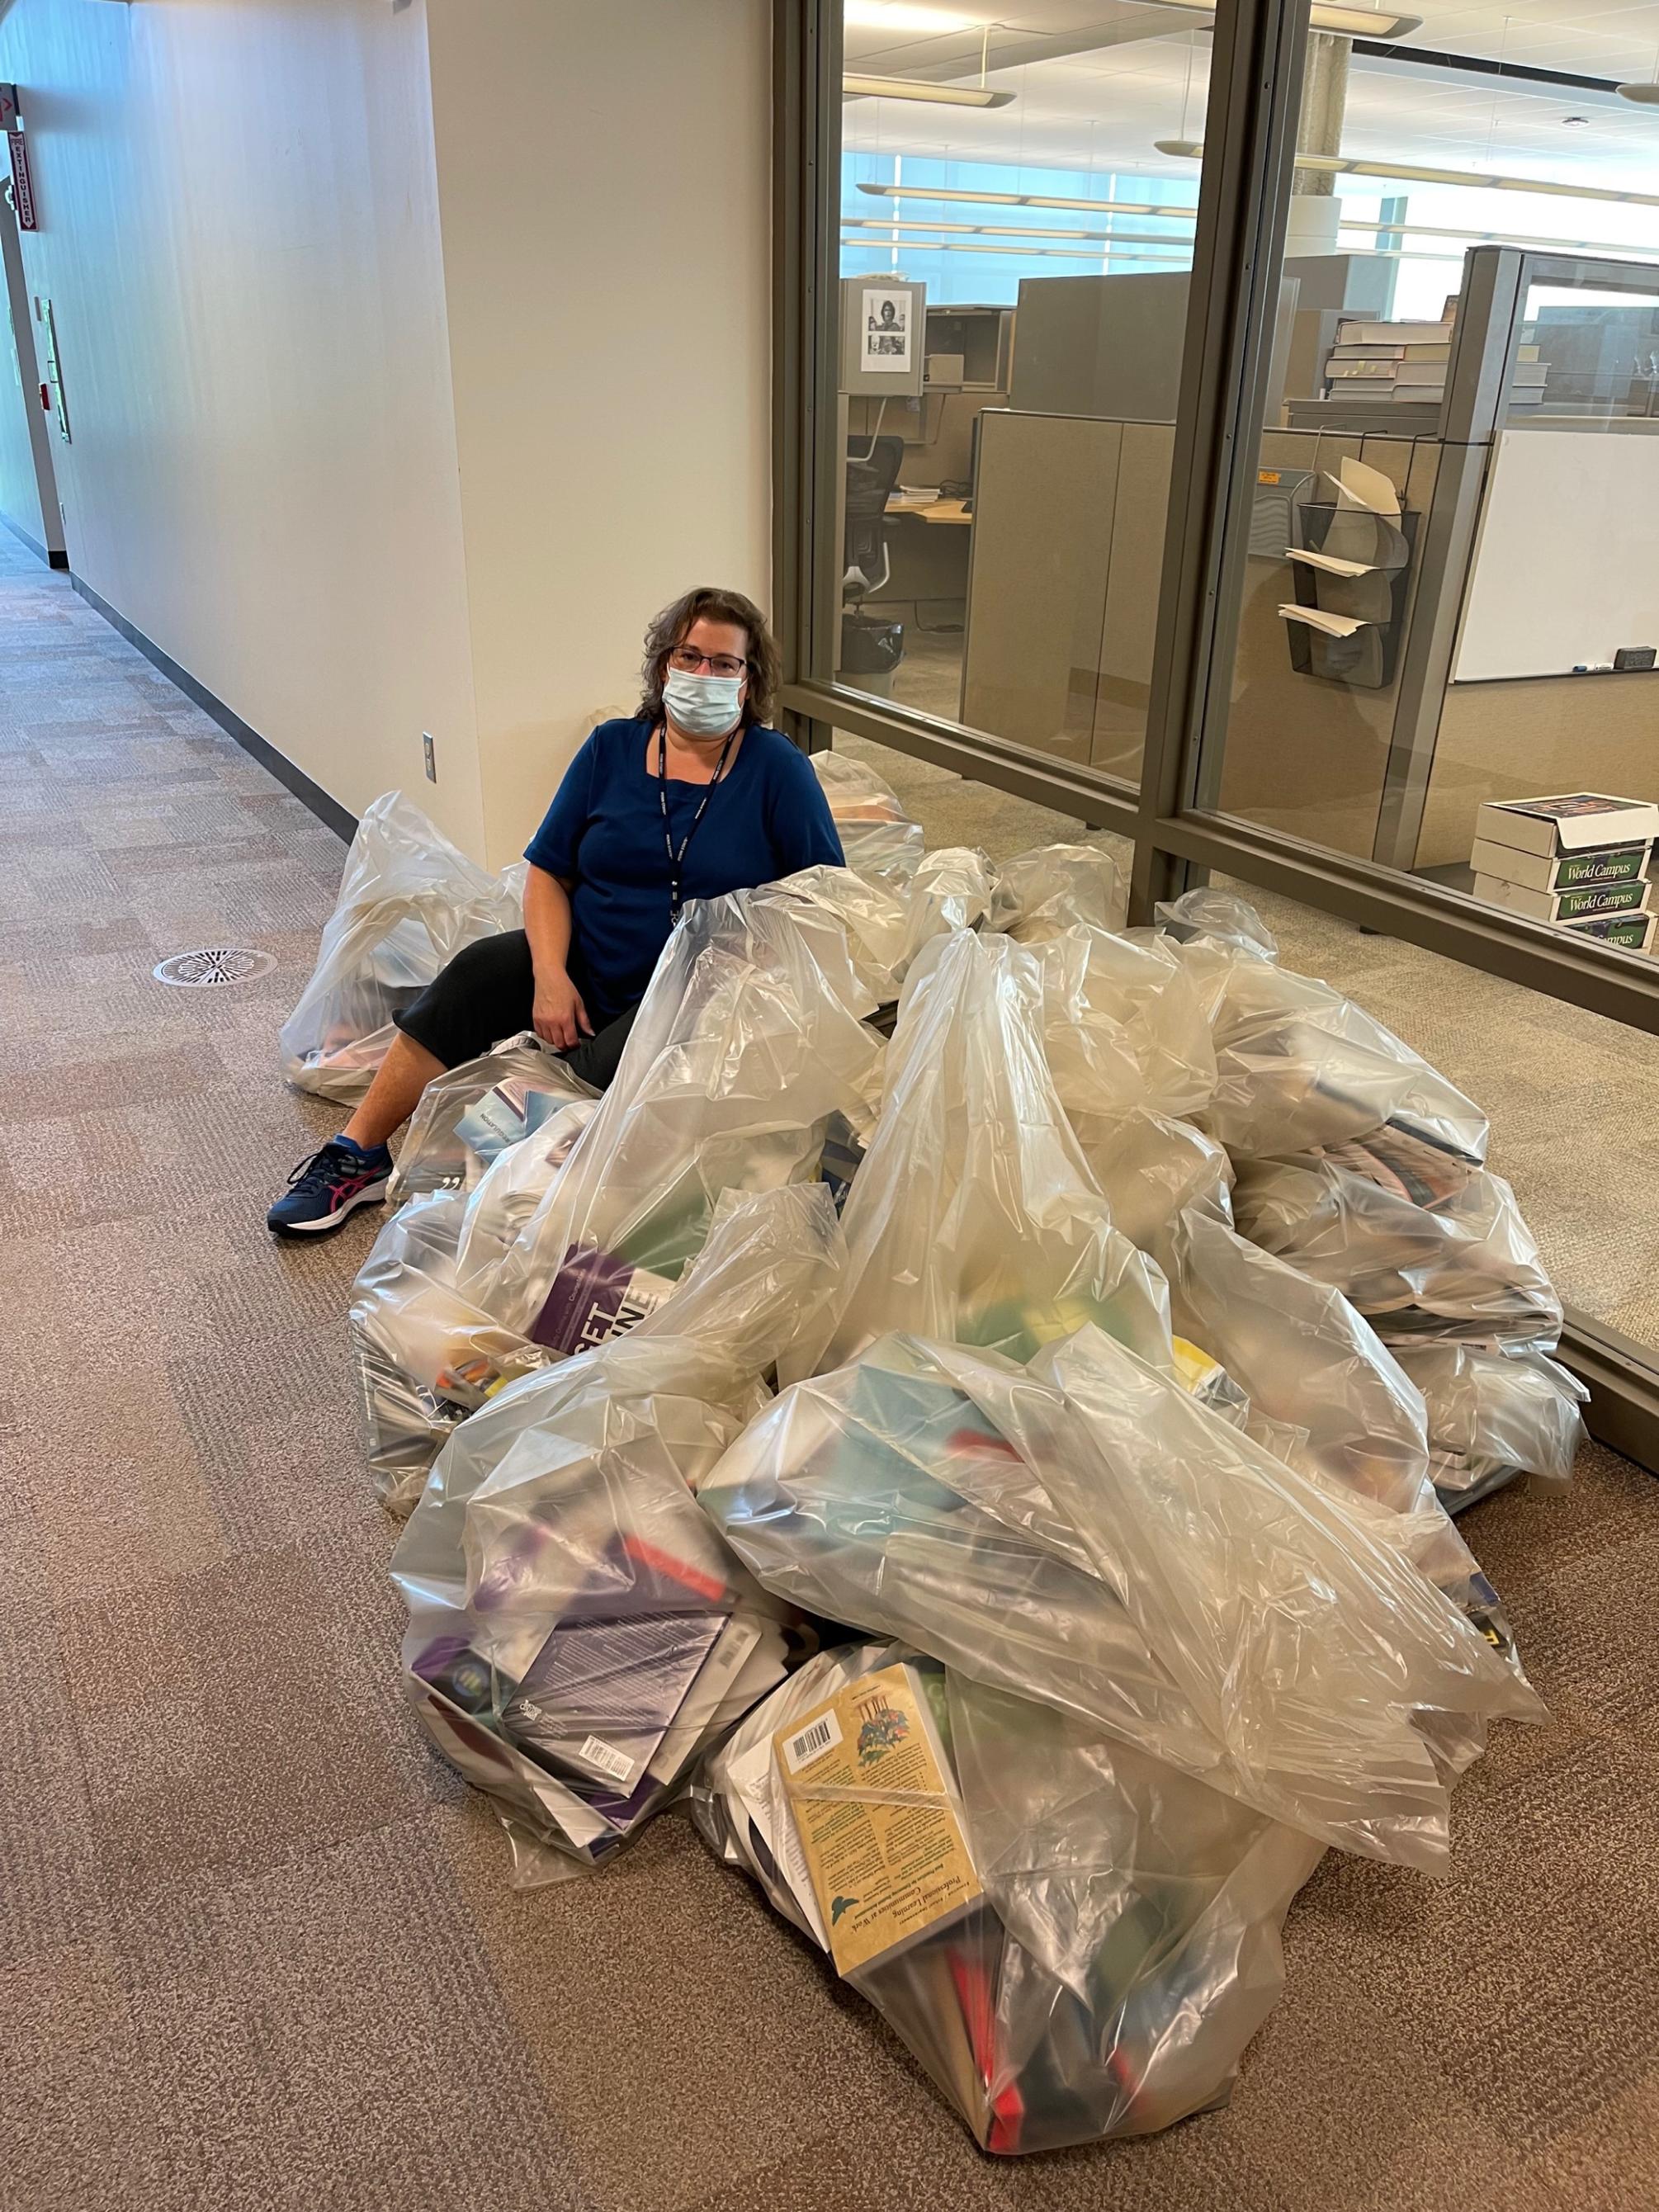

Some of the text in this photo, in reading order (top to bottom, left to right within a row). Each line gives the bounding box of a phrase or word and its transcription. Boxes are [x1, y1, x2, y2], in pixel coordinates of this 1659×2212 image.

[15, 146, 31, 223] EXTINGUISHER
[1568, 863, 1631, 880] World Campus
[1570, 893, 1633, 911] World Campus
[1597, 934, 1634, 945] mpus
[480, 1113, 510, 1144] REGULATION
[920, 1874, 961, 1902] Professional
[877, 1885, 922, 1917] Communities
[891, 1897, 922, 1920] Learning
[850, 1917, 870, 1932] Work
[870, 1912, 878, 1920] at
